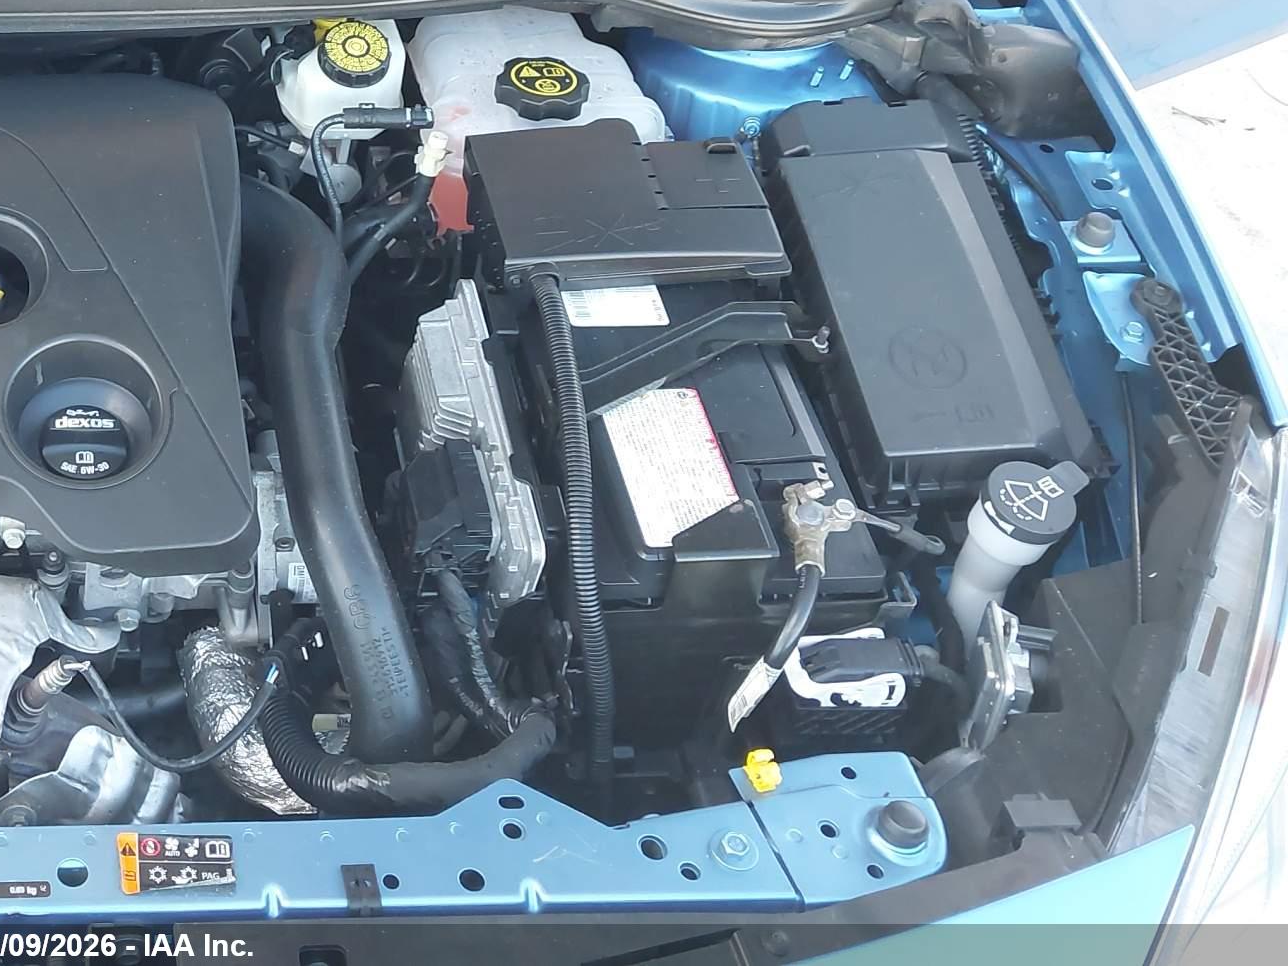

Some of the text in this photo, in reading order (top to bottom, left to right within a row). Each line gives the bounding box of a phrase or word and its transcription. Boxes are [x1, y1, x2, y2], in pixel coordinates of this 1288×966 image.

[55, 416, 115, 428] dexos
[60, 461, 78, 474] SAE
[201, 872, 220, 880] PAG
